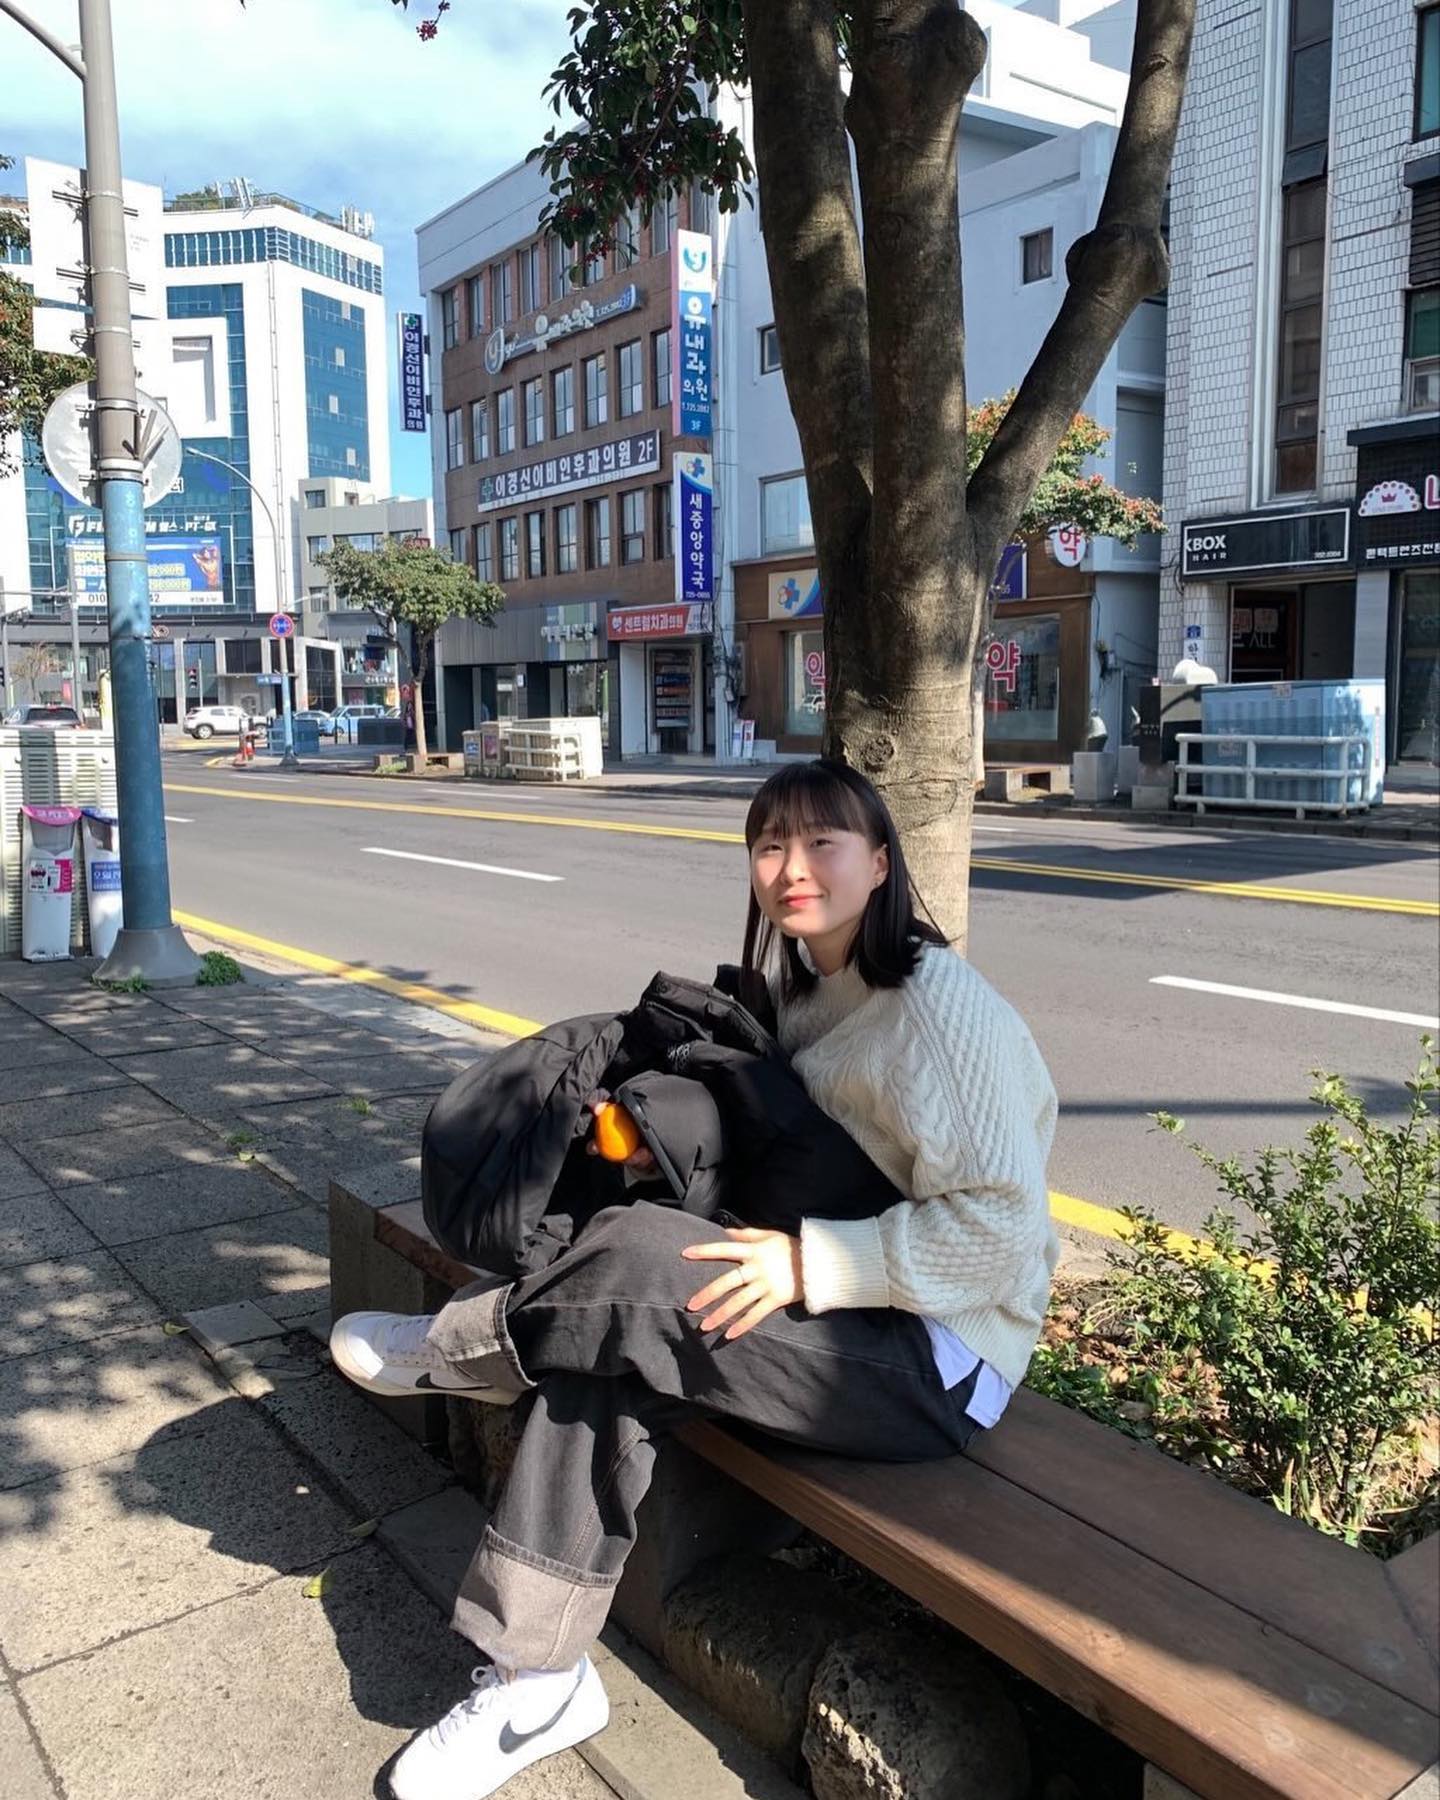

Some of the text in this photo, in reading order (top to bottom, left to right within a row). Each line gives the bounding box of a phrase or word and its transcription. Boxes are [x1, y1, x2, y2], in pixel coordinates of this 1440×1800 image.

[691, 419, 702, 431] 3F
[495, 438, 654, 498] 이경신이비인후과의원 2F
[1192, 552, 1227, 562] HAIR
[986, 641, 1021, 693] 약
